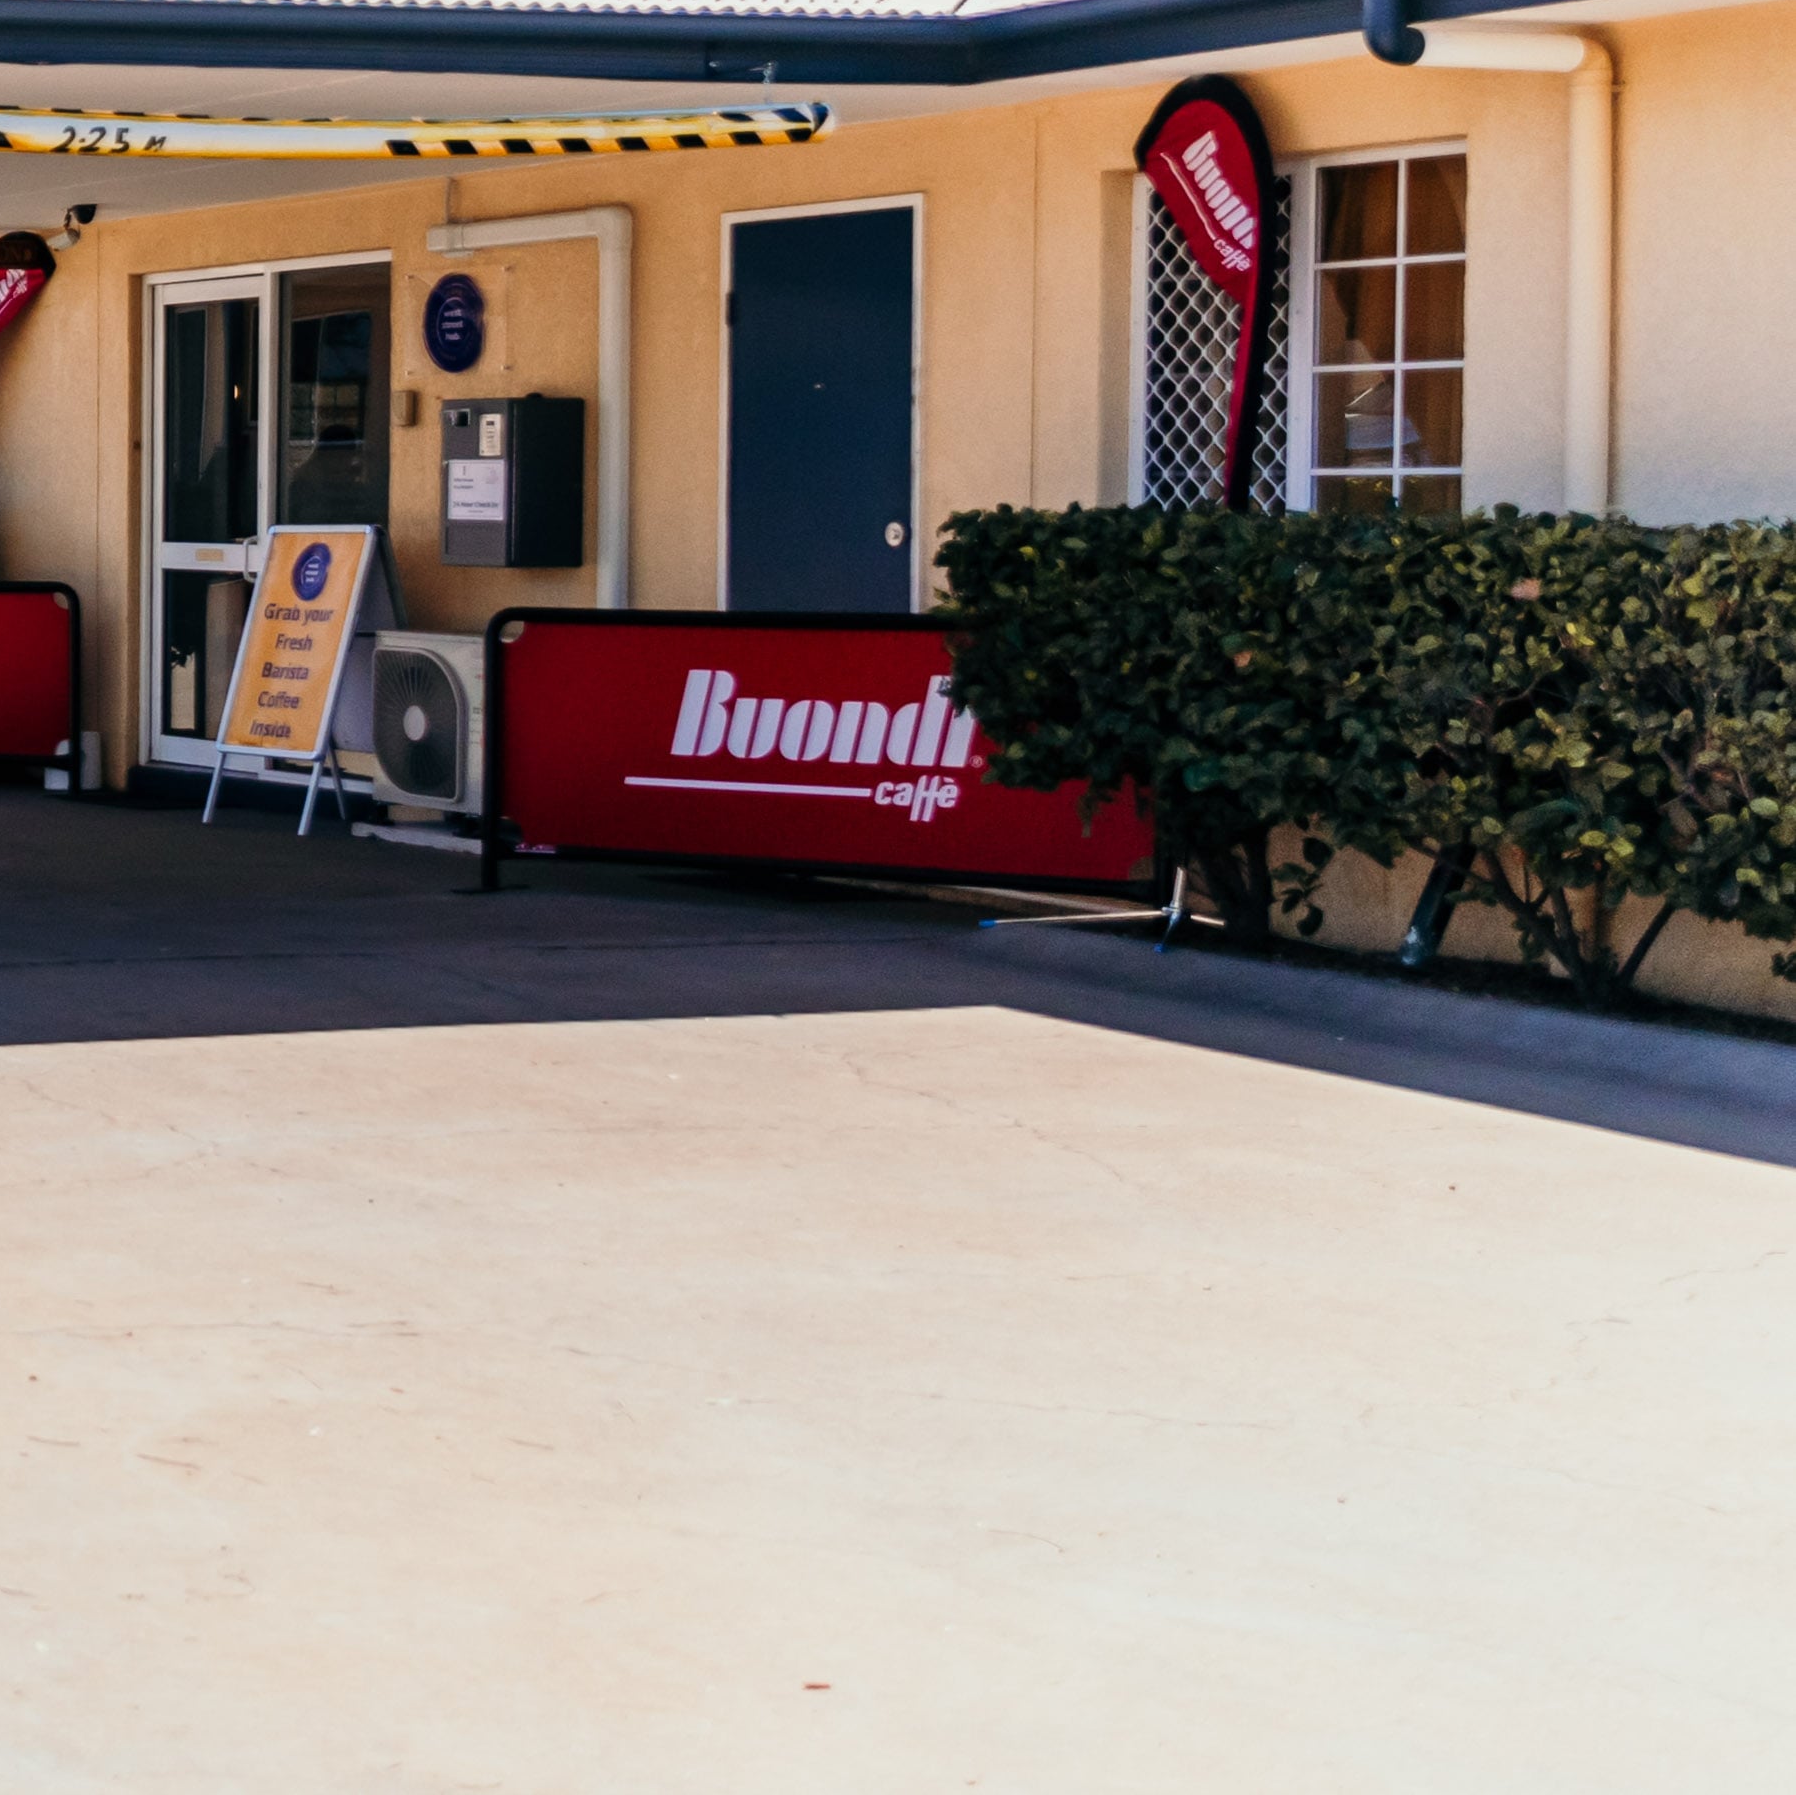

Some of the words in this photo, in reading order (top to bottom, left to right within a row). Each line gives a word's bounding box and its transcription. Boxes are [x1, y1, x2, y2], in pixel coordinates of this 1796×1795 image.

[1182, 130, 1255, 250] Buond
[263, 603, 300, 622] Grab
[302, 608, 334, 626] your
[275, 633, 313, 652] Fresh
[262, 661, 310, 681] Barista
[257, 690, 300, 710] Coffee
[249, 719, 291, 739] Inside
[873, 774, 959, 823] caffè
